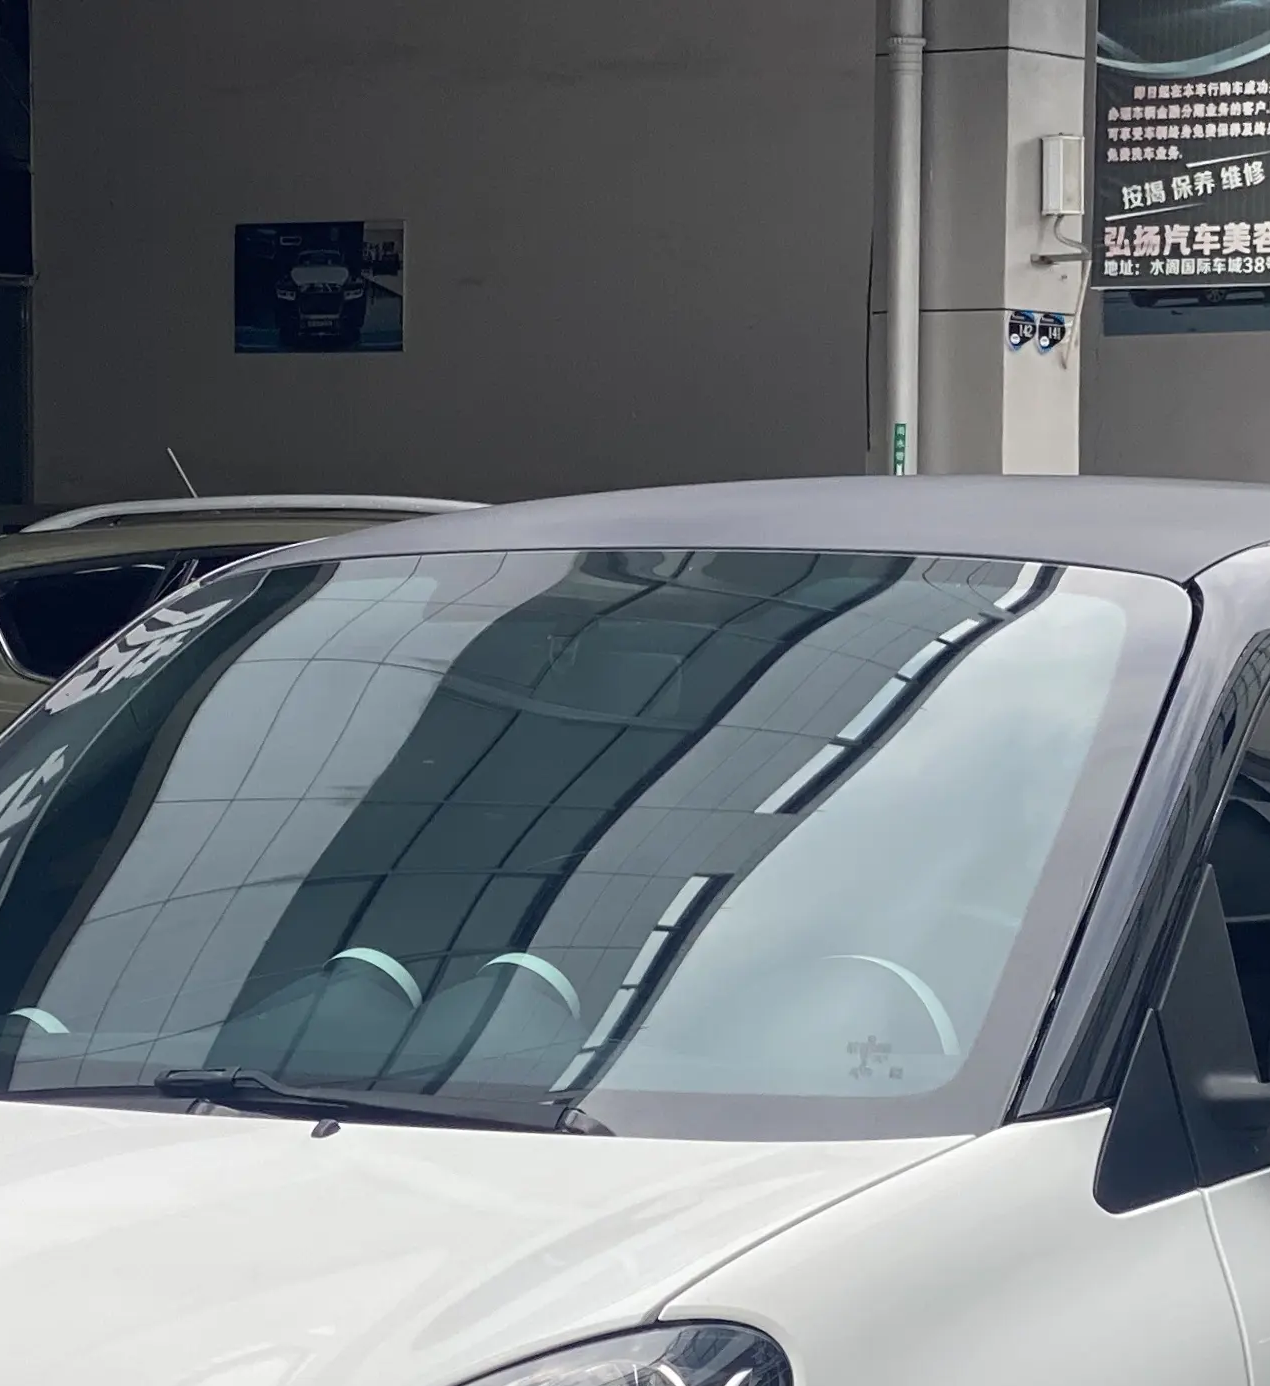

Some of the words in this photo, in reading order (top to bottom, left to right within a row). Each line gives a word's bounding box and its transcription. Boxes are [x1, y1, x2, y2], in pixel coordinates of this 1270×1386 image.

[1121, 180, 1166, 210] 按揭
[1171, 170, 1216, 200] 保养
[1220, 161, 1266, 191] 维修
